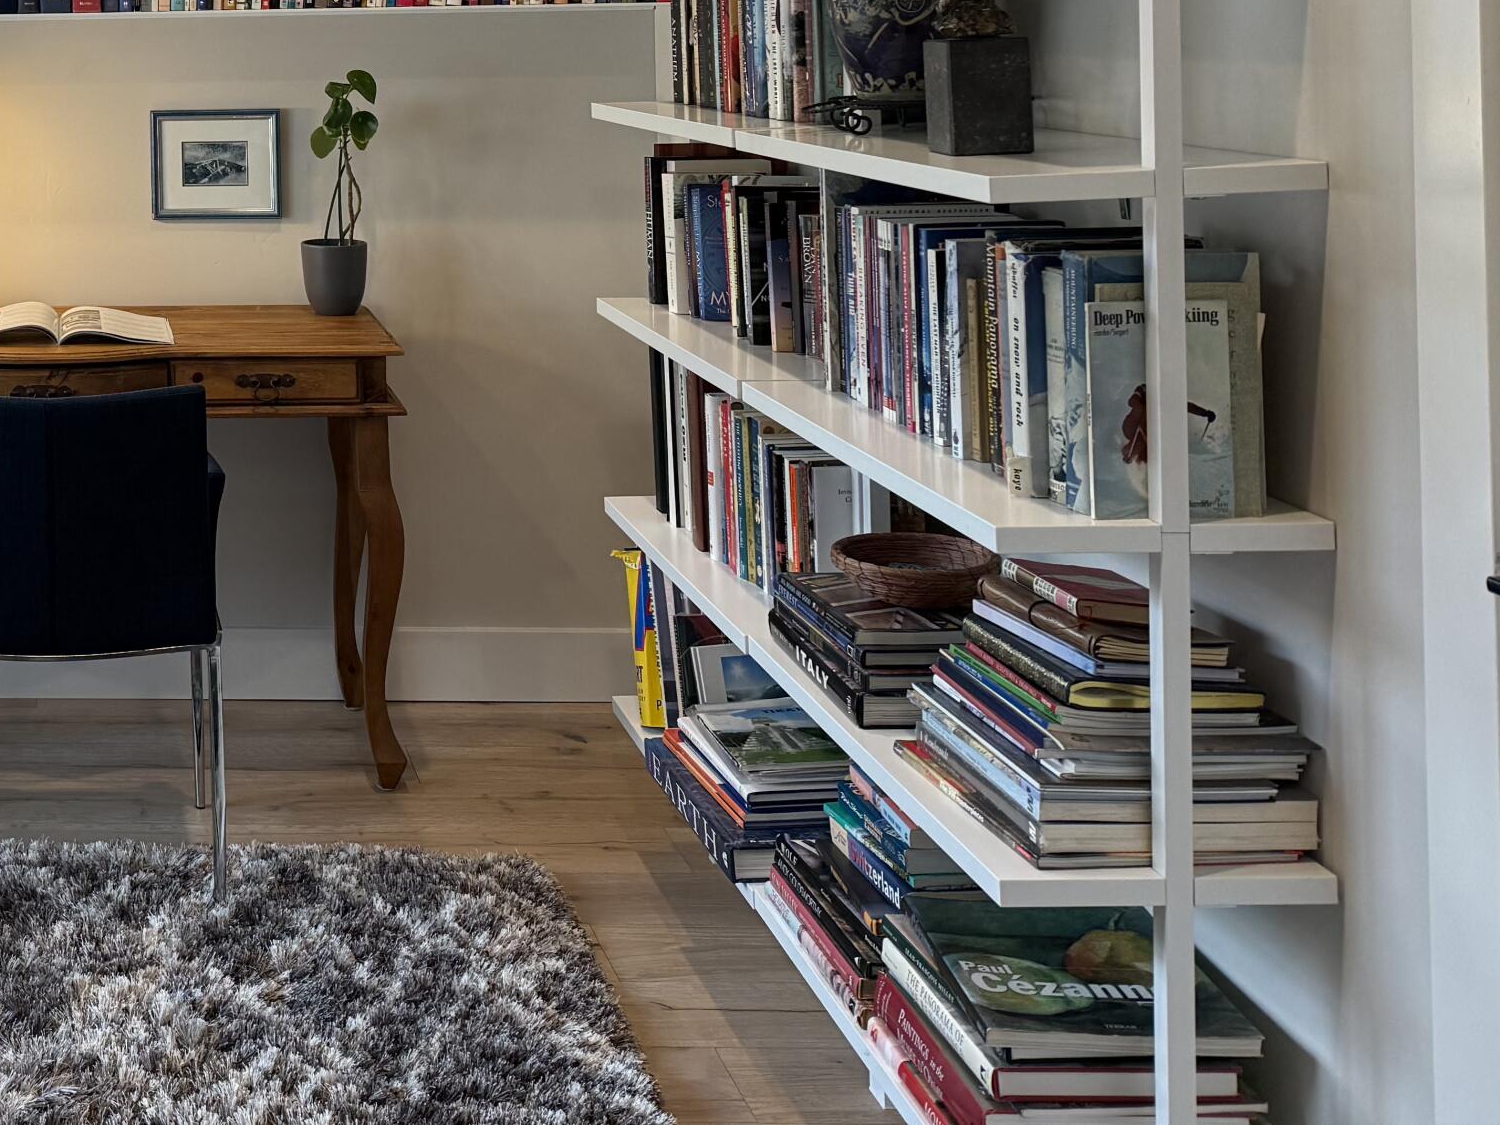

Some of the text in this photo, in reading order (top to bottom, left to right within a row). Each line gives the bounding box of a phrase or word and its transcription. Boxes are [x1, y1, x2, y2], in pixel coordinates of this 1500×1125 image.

[646, 211, 654, 258] HUMAN
[803, 237, 812, 283] BROWN
[985, 243, 1000, 389] Mountain Panorama
[1069, 269, 1077, 349] MOUNTAINEERING
[1094, 308, 1220, 328] Deep Pow kiing
[1013, 317, 1024, 427] on snow and rock
[1013, 468, 1023, 491] kaye
[778, 583, 798, 607] EVEREST
[796, 645, 828, 689] ITALY
[652, 751, 718, 863] EARTH
[850, 841, 902, 911] Switzerland
[958, 959, 1012, 975] Paul
[970, 971, 1154, 1000] Cézann
[906, 969, 964, 1048] THE PANORAMA OF
[898, 1007, 944, 1082] PAINTINGS in the
